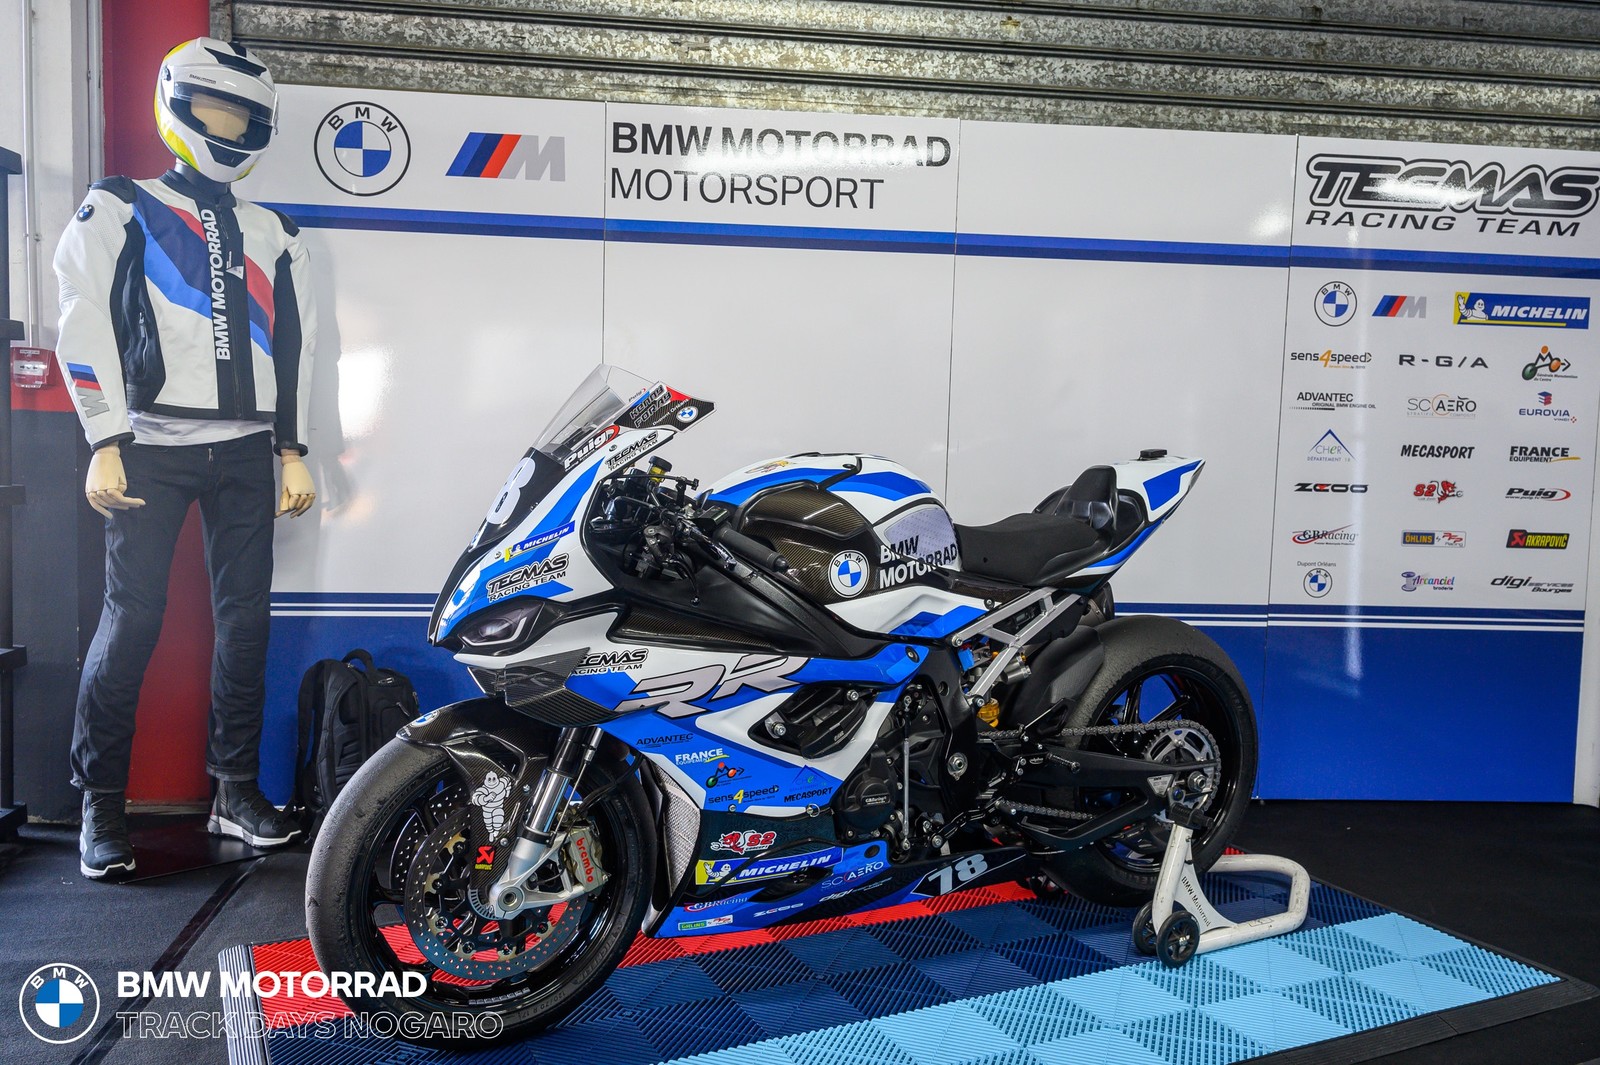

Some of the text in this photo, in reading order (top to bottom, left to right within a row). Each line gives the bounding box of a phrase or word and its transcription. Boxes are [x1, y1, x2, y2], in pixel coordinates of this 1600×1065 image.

[327, 106, 400, 132] BMW
[612, 121, 952, 168] BMW MOTORRAD
[610, 167, 885, 210] MOTORSPORT
[1306, 153, 1600, 218] TECMAS
[1306, 210, 1581, 237] RACING TEAM
[201, 208, 232, 361] BMW MOTORRAD
[1321, 283, 1353, 297] BMW
[1491, 304, 1588, 321] MICHELIN
[1290, 349, 1368, 368] sens4speed
[1296, 392, 1354, 403] ADVANTEC
[1519, 408, 1570, 417] EUROVIA
[564, 430, 608, 469] Puig
[606, 431, 658, 467] TECMAS
[610, 453, 637, 471] RACING
[638, 440, 658, 453] TEAM
[1401, 445, 1475, 460] MECASPORT
[1510, 445, 1570, 457] FRANCE
[1413, 484, 1437, 498] S2
[1506, 488, 1559, 499] Puig
[523, 526, 570, 549] MICHELIN
[1303, 529, 1357, 542] GBRacing
[1405, 533, 1433, 543] ÖHLINS
[880, 535, 920, 564] BMW
[834, 553, 863, 568] BMW
[879, 543, 958, 589] MOTORRAD
[486, 553, 570, 597] TECMAS
[1413, 575, 1455, 586] Arcanciel
[1490, 576, 1532, 589] digi
[489, 571, 567, 602] RACING TEAM
[577, 648, 650, 668] ECMAS
[573, 663, 643, 676] ACING TEAM
[636, 733, 694, 745] ADVANTEC
[675, 748, 724, 762] FRANCE
[708, 786, 776, 804] sens4speed
[784, 787, 833, 803] MECASPORT
[747, 832, 776, 847] S2
[576, 837, 594, 884] brembo
[739, 855, 831, 878] MICHELIN
[927, 853, 988, 896] 78
[1181, 876, 1212, 928] BMW Motorrad
